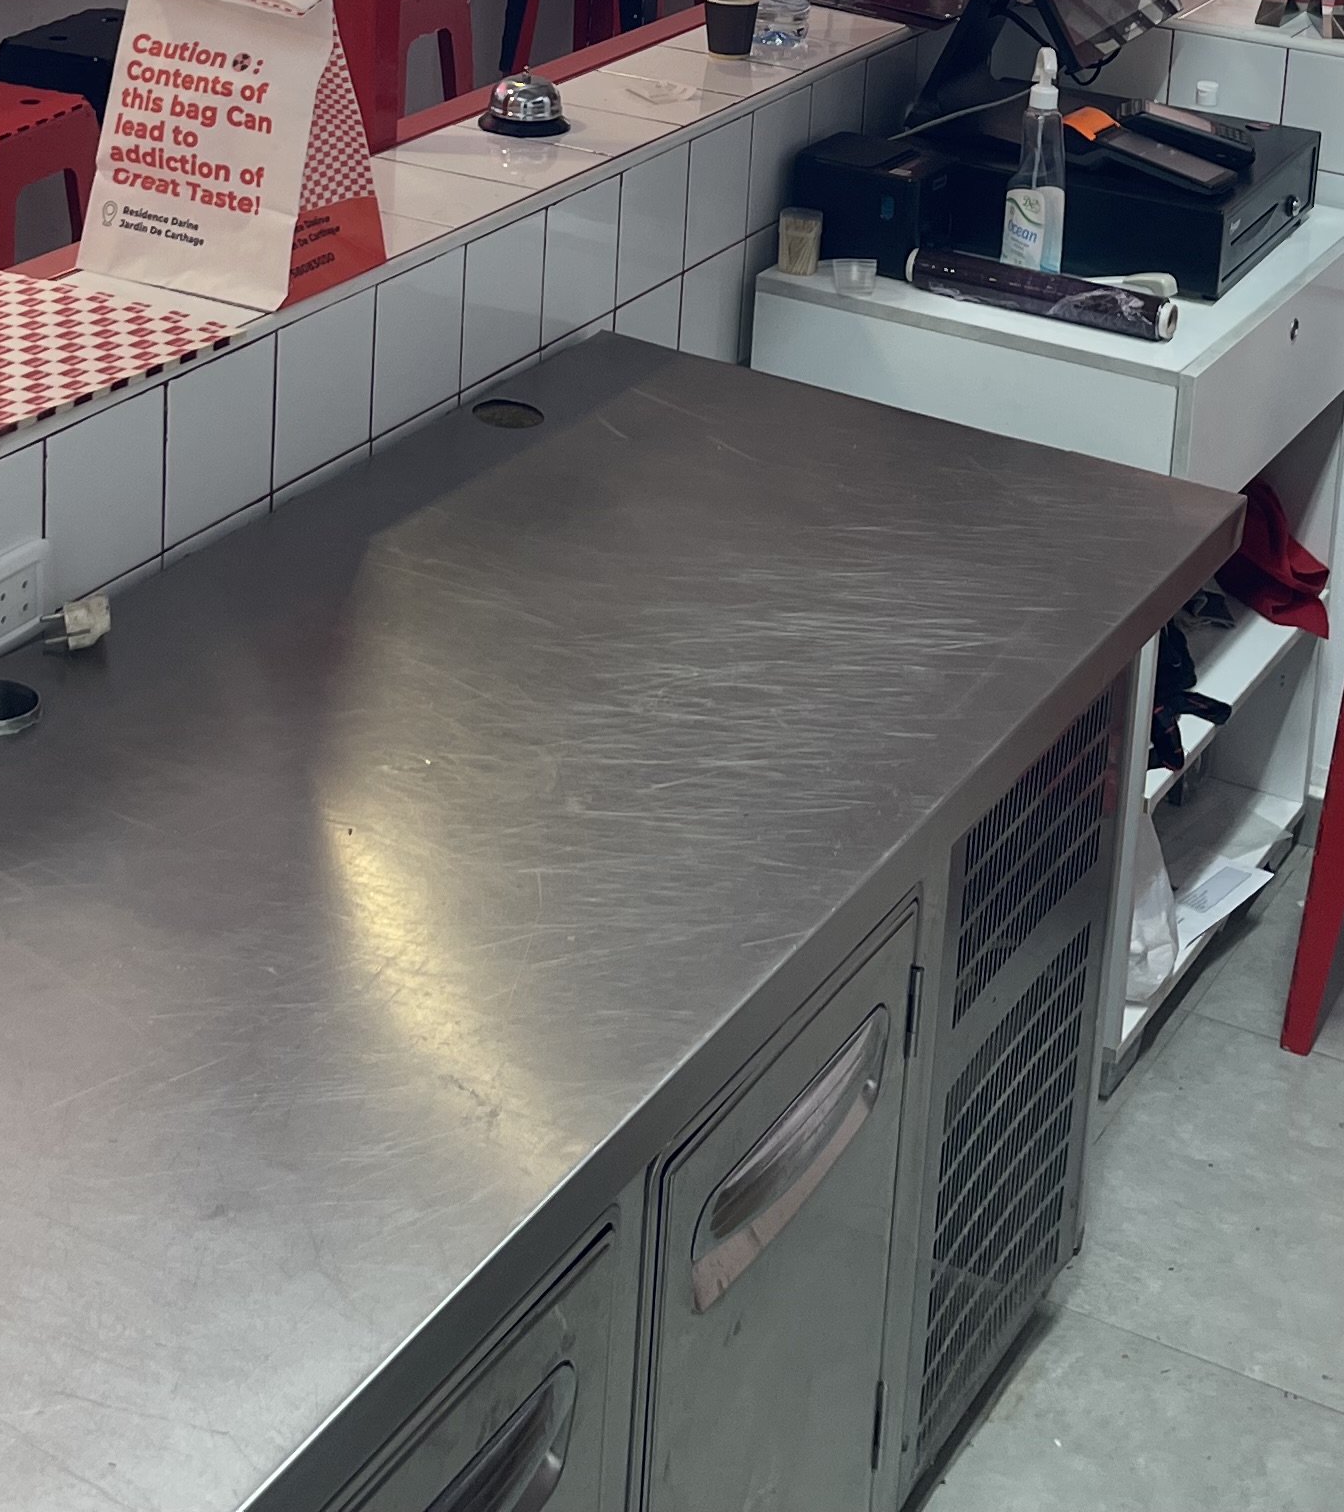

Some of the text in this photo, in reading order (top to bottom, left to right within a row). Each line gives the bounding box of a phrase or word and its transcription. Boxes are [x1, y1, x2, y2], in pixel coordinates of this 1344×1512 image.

[132, 33, 227, 69] Caution
[126, 59, 270, 104] Contents of
[114, 112, 199, 148] lead to
[121, 86, 272, 135] this bag Can
[109, 144, 265, 188] addiction of
[112, 167, 261, 216] Great Taste!
[119, 218, 205, 247] Jardin De Carthage
[122, 205, 199, 231] Residence Darine
